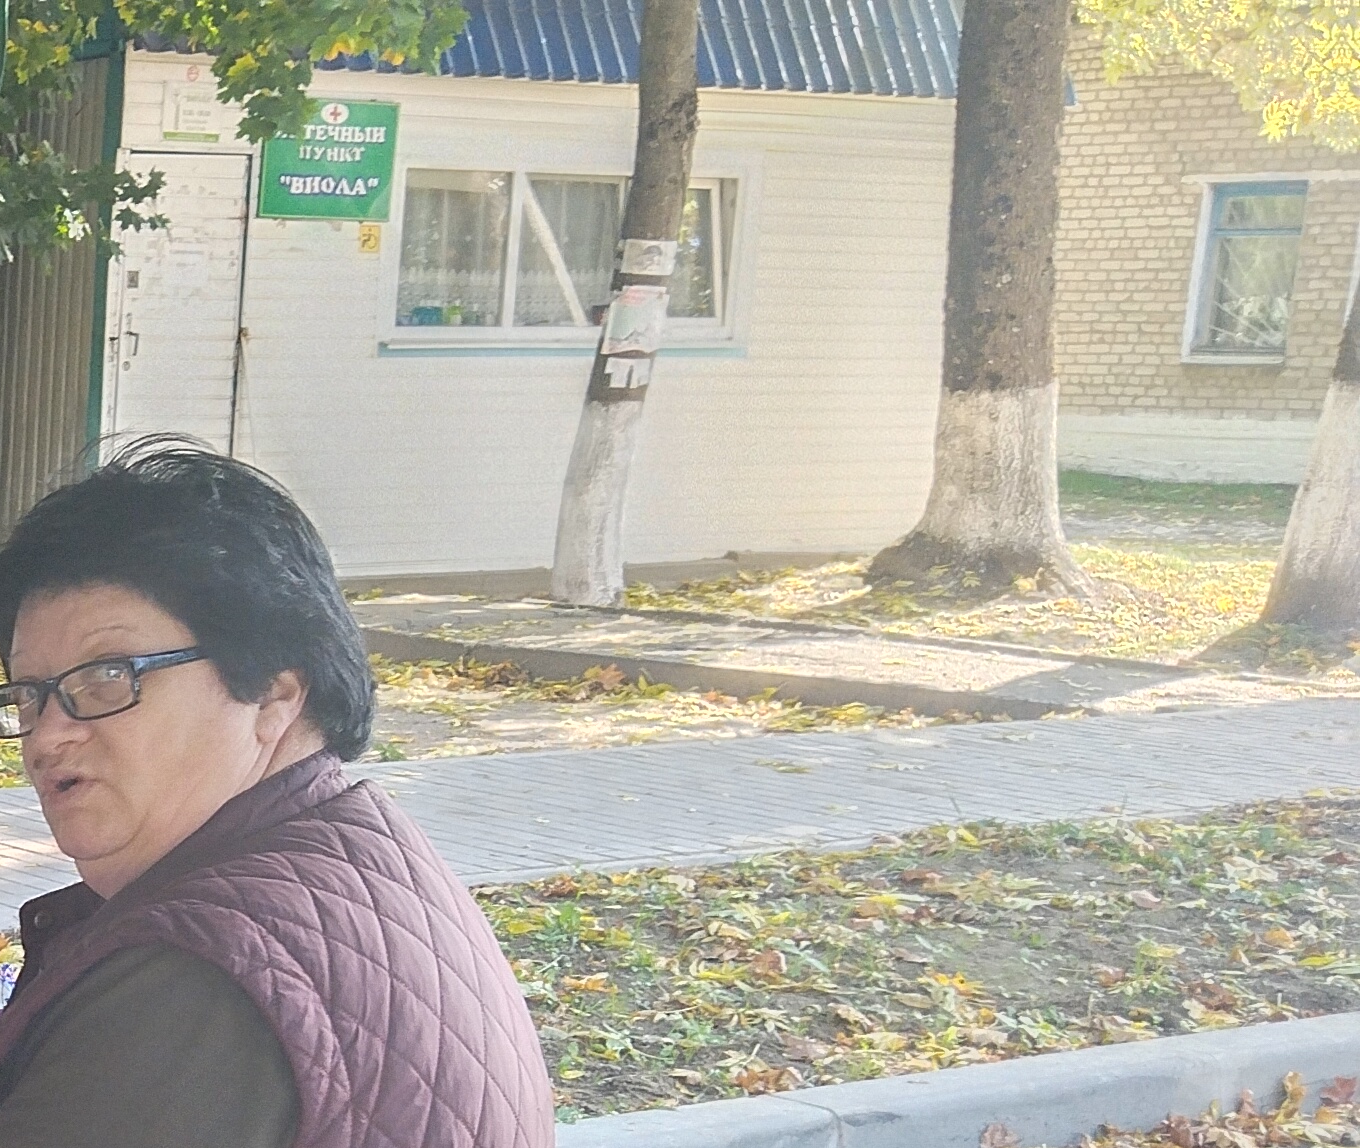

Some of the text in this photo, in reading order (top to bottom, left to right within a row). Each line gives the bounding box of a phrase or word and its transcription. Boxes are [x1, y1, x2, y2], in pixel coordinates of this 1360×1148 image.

[274, 124, 387, 143] ТЕЧНЫЙ
[298, 144, 366, 162] ПУНКТ
[280, 175, 379, 196] "ВИОЛА"
